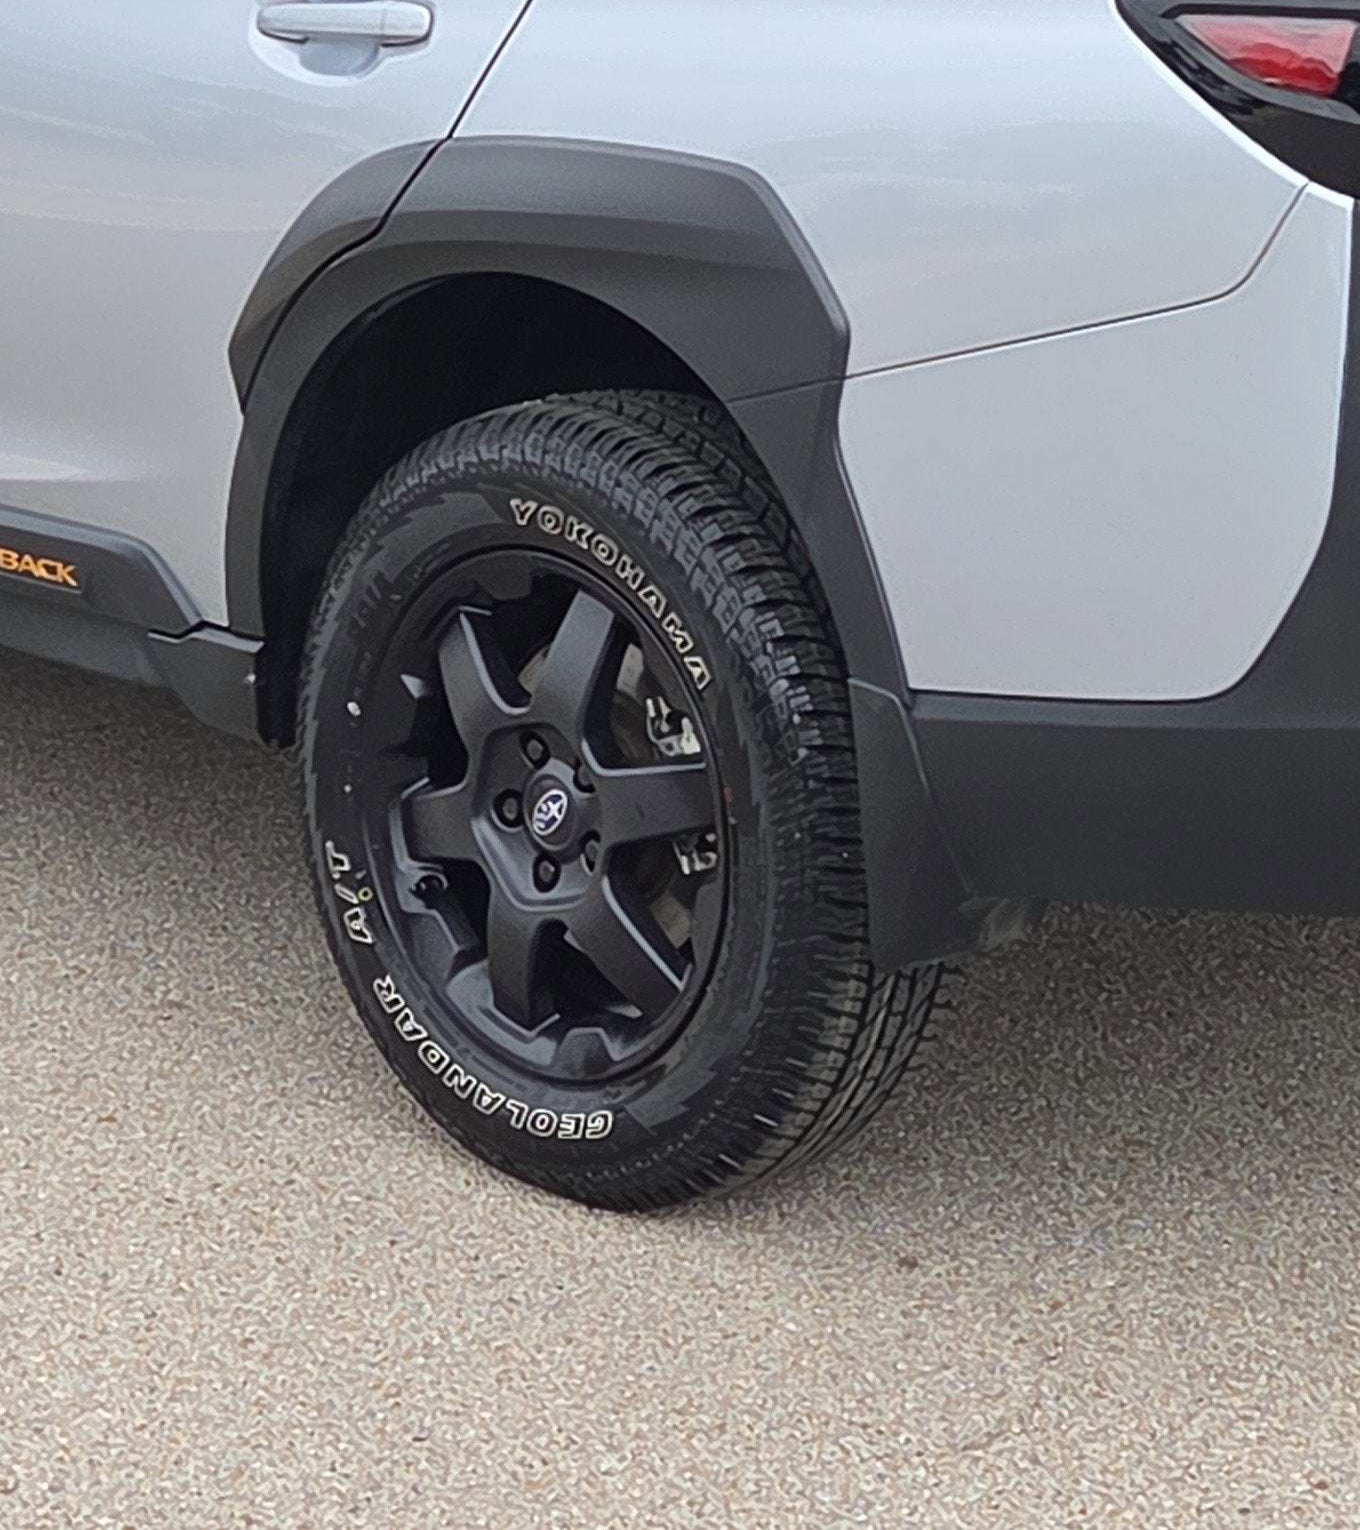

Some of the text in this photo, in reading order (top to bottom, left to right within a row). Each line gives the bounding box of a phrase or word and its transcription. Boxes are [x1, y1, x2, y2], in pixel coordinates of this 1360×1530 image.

[509, 497, 712, 691] YOKOHAMA
[324, 839, 612, 1139] GEOLANDAR A/T
